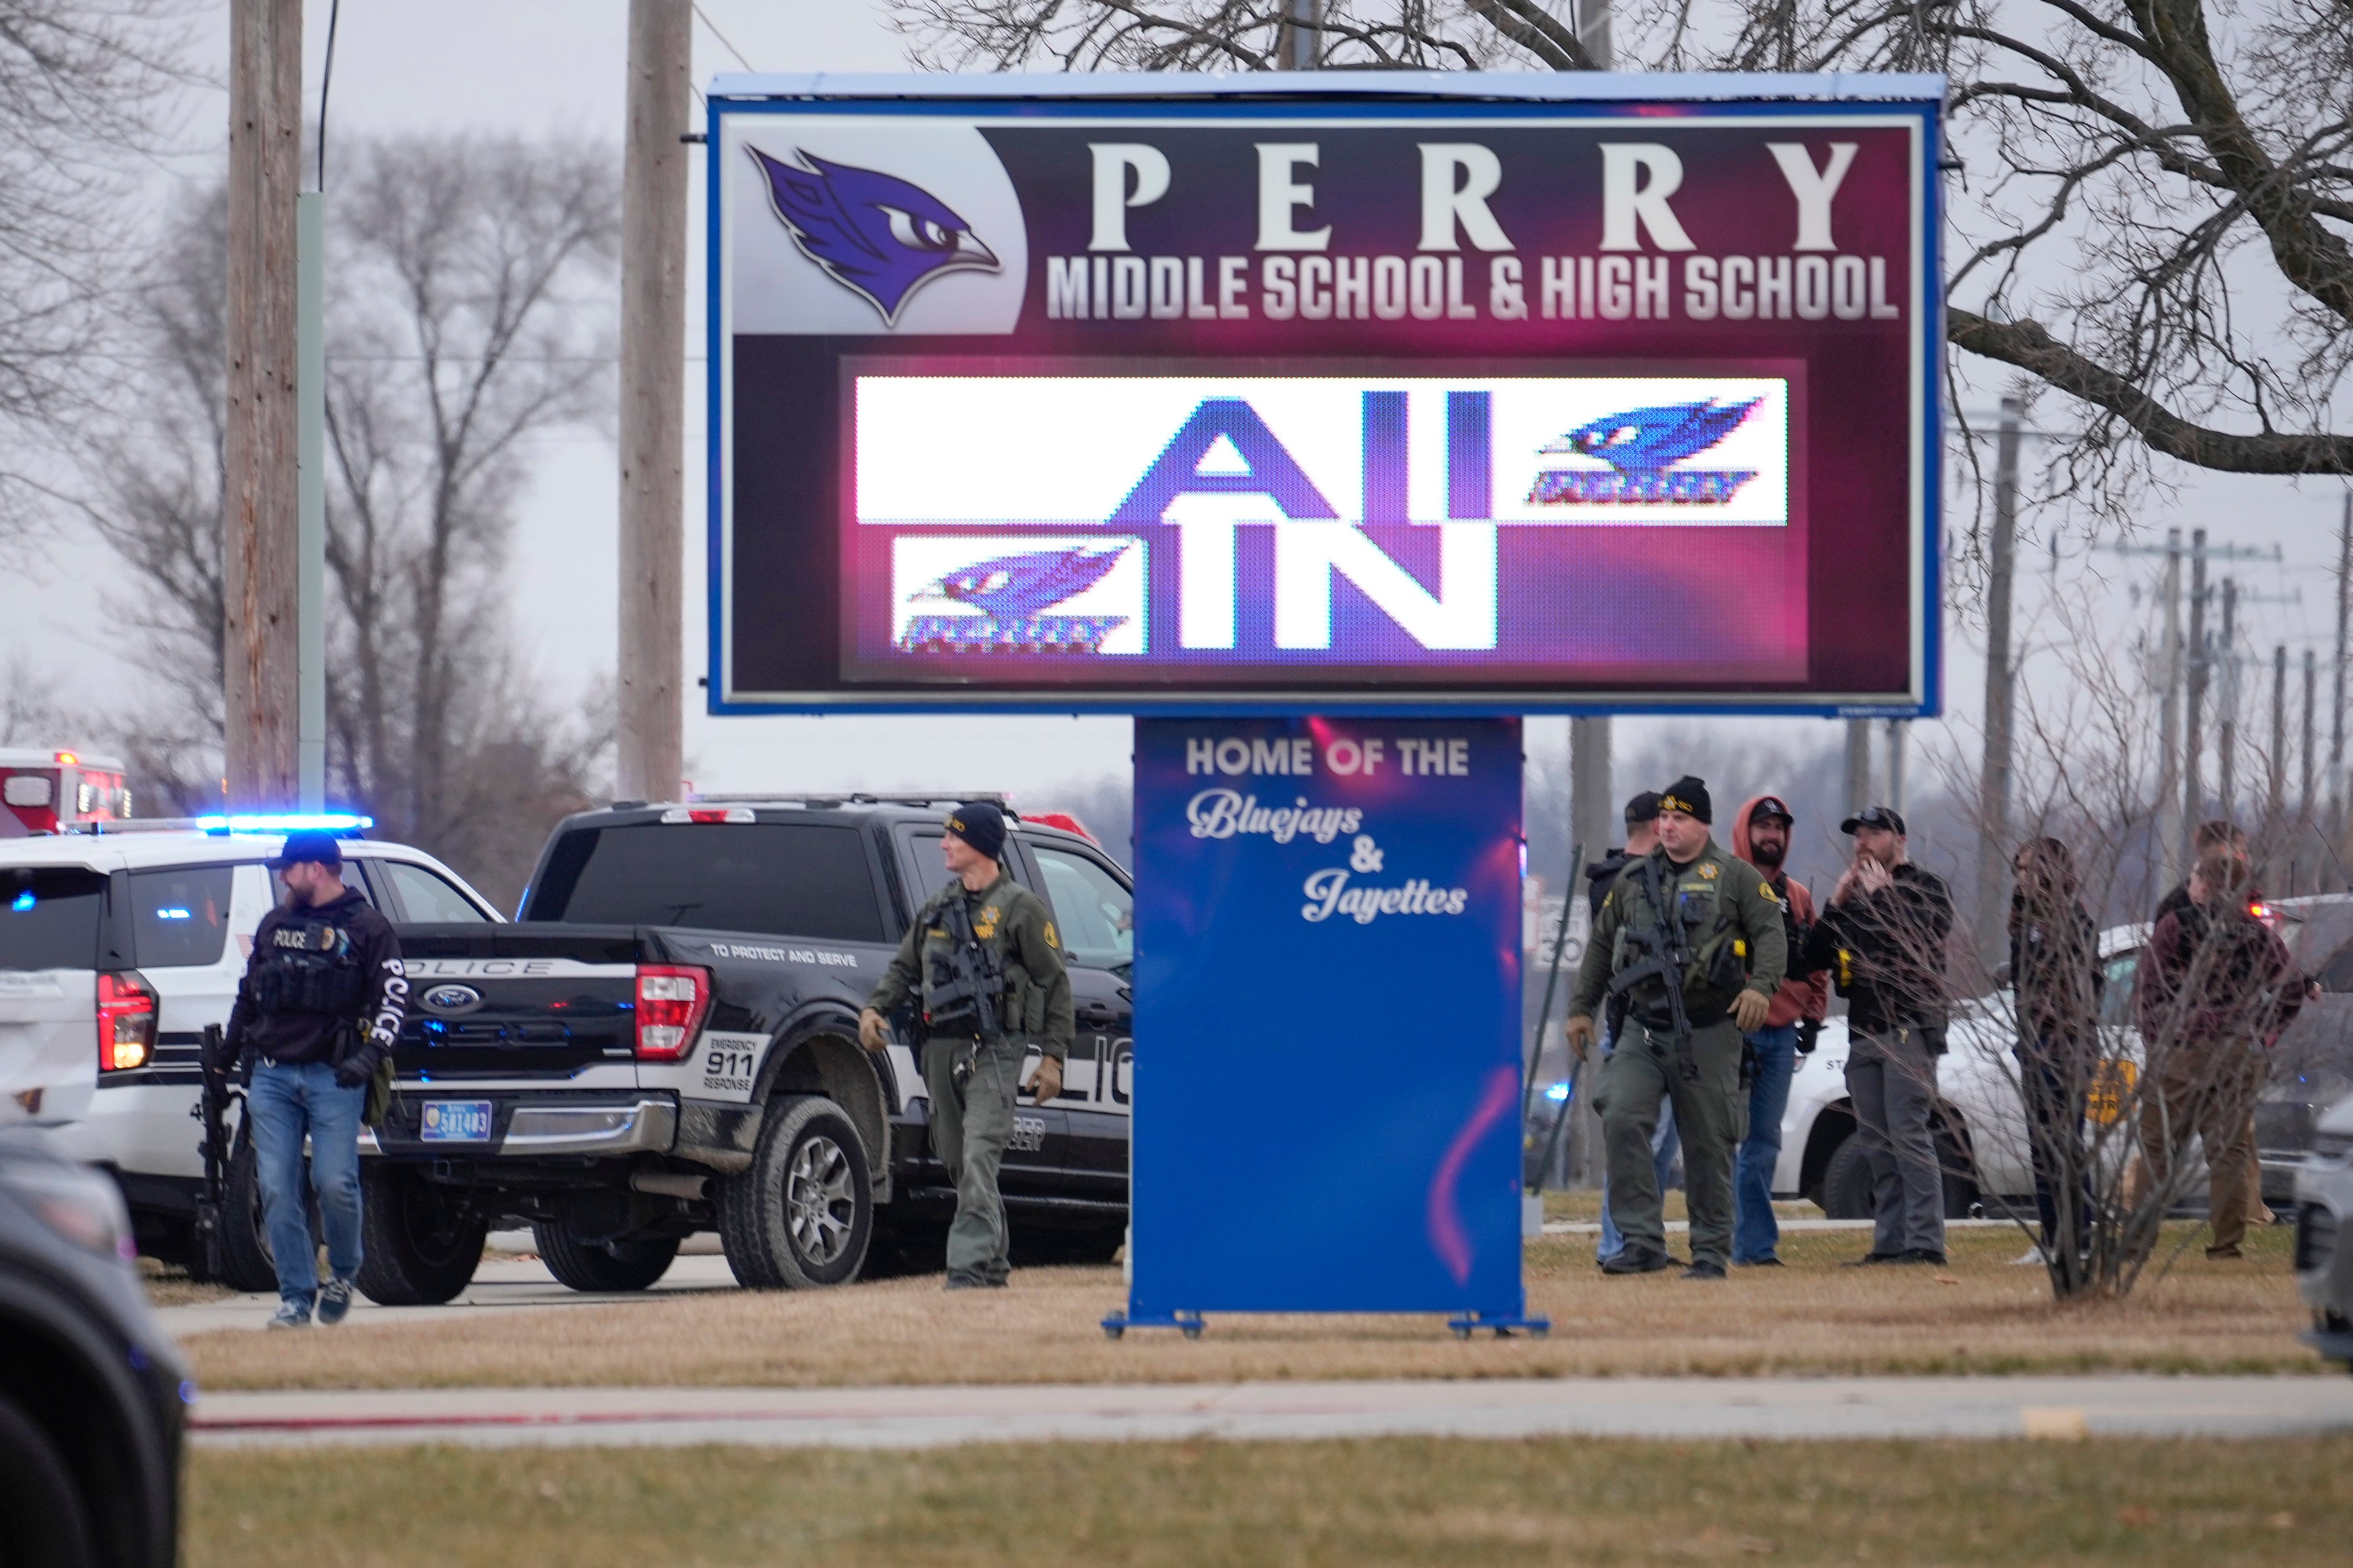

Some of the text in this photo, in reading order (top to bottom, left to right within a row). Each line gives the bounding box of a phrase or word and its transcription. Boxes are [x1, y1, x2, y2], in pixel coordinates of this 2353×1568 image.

[1087, 142, 1859, 251] PERRY
[1047, 255, 1900, 321] MIDDLE SCHOOL & HIGH SCHOOL
[1186, 737, 1469, 776] HOME OF THE
[1186, 788, 1363, 844] Bluejays
[1349, 834, 1384, 874] &
[1301, 868, 1468, 925] Jayettes
[272, 929, 307, 950] POLICE
[710, 943, 858, 968] TO PROTECT AND SERVE
[404, 961, 553, 975] OLICE
[706, 1052, 753, 1076] 911
